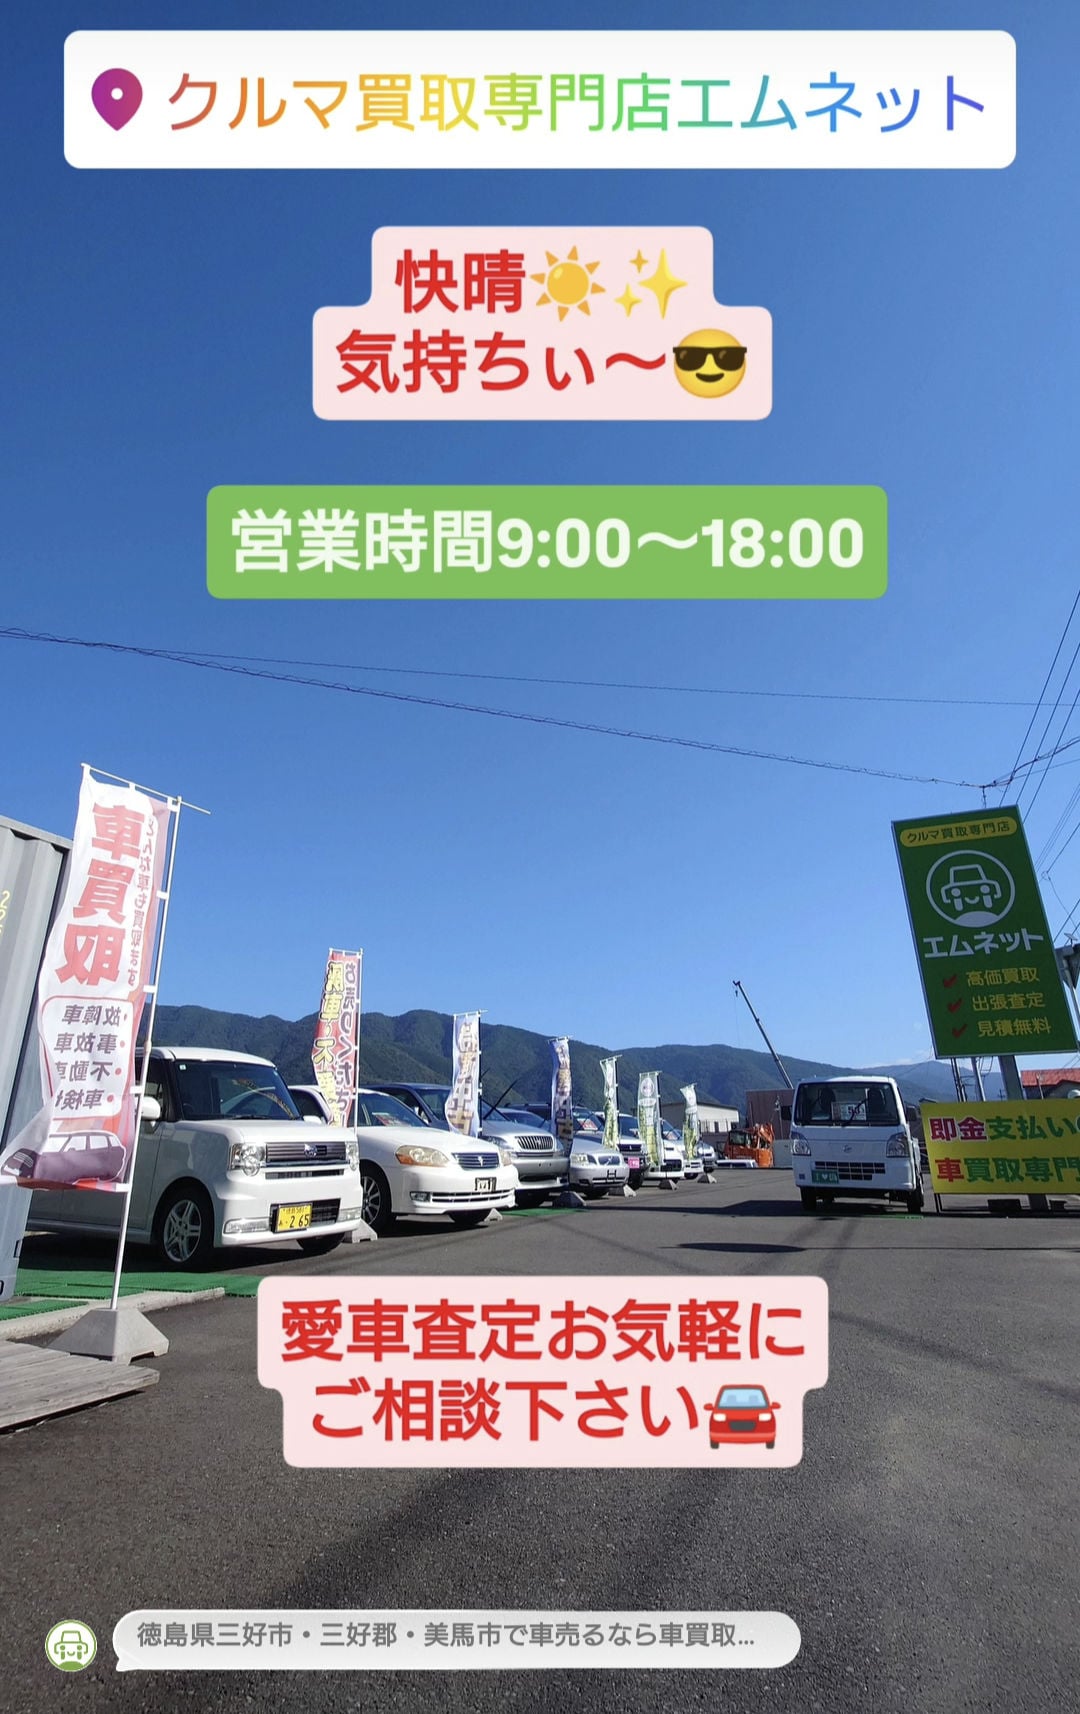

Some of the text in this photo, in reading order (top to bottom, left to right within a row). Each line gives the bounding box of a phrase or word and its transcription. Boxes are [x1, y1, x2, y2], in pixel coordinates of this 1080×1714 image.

[907, 820, 1011, 844] クルマ買取専門店
[923, 927, 1044, 959] エムネット
[966, 966, 1040, 987] 高価買取
[972, 991, 1046, 1012] 出張査定
[977, 1016, 1052, 1038] 見積無料
[928, 1115, 1080, 1142] 即金支払い
[935, 1156, 1080, 1183] 車買取専門
